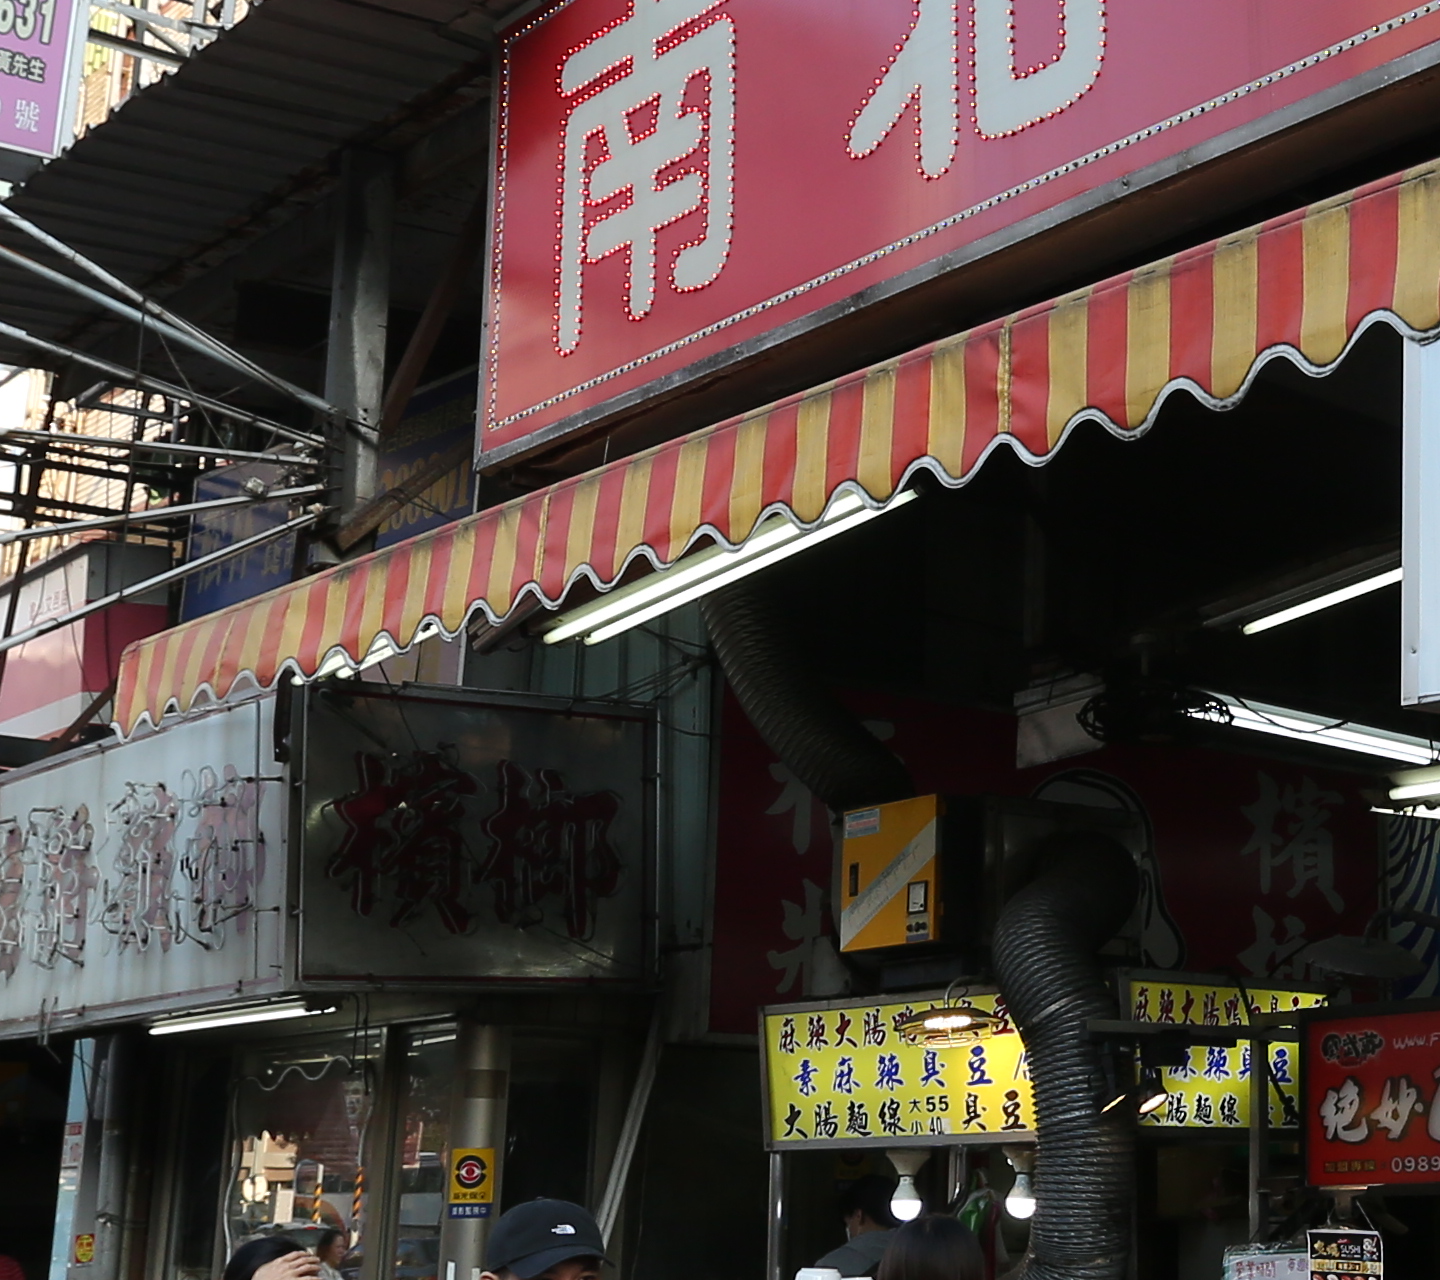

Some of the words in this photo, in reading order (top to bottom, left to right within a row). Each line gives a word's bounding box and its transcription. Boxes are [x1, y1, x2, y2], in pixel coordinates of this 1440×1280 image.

[783, 1098, 908, 1139] 大腸麵線
[962, 1090, 1028, 1132] 臭豆
